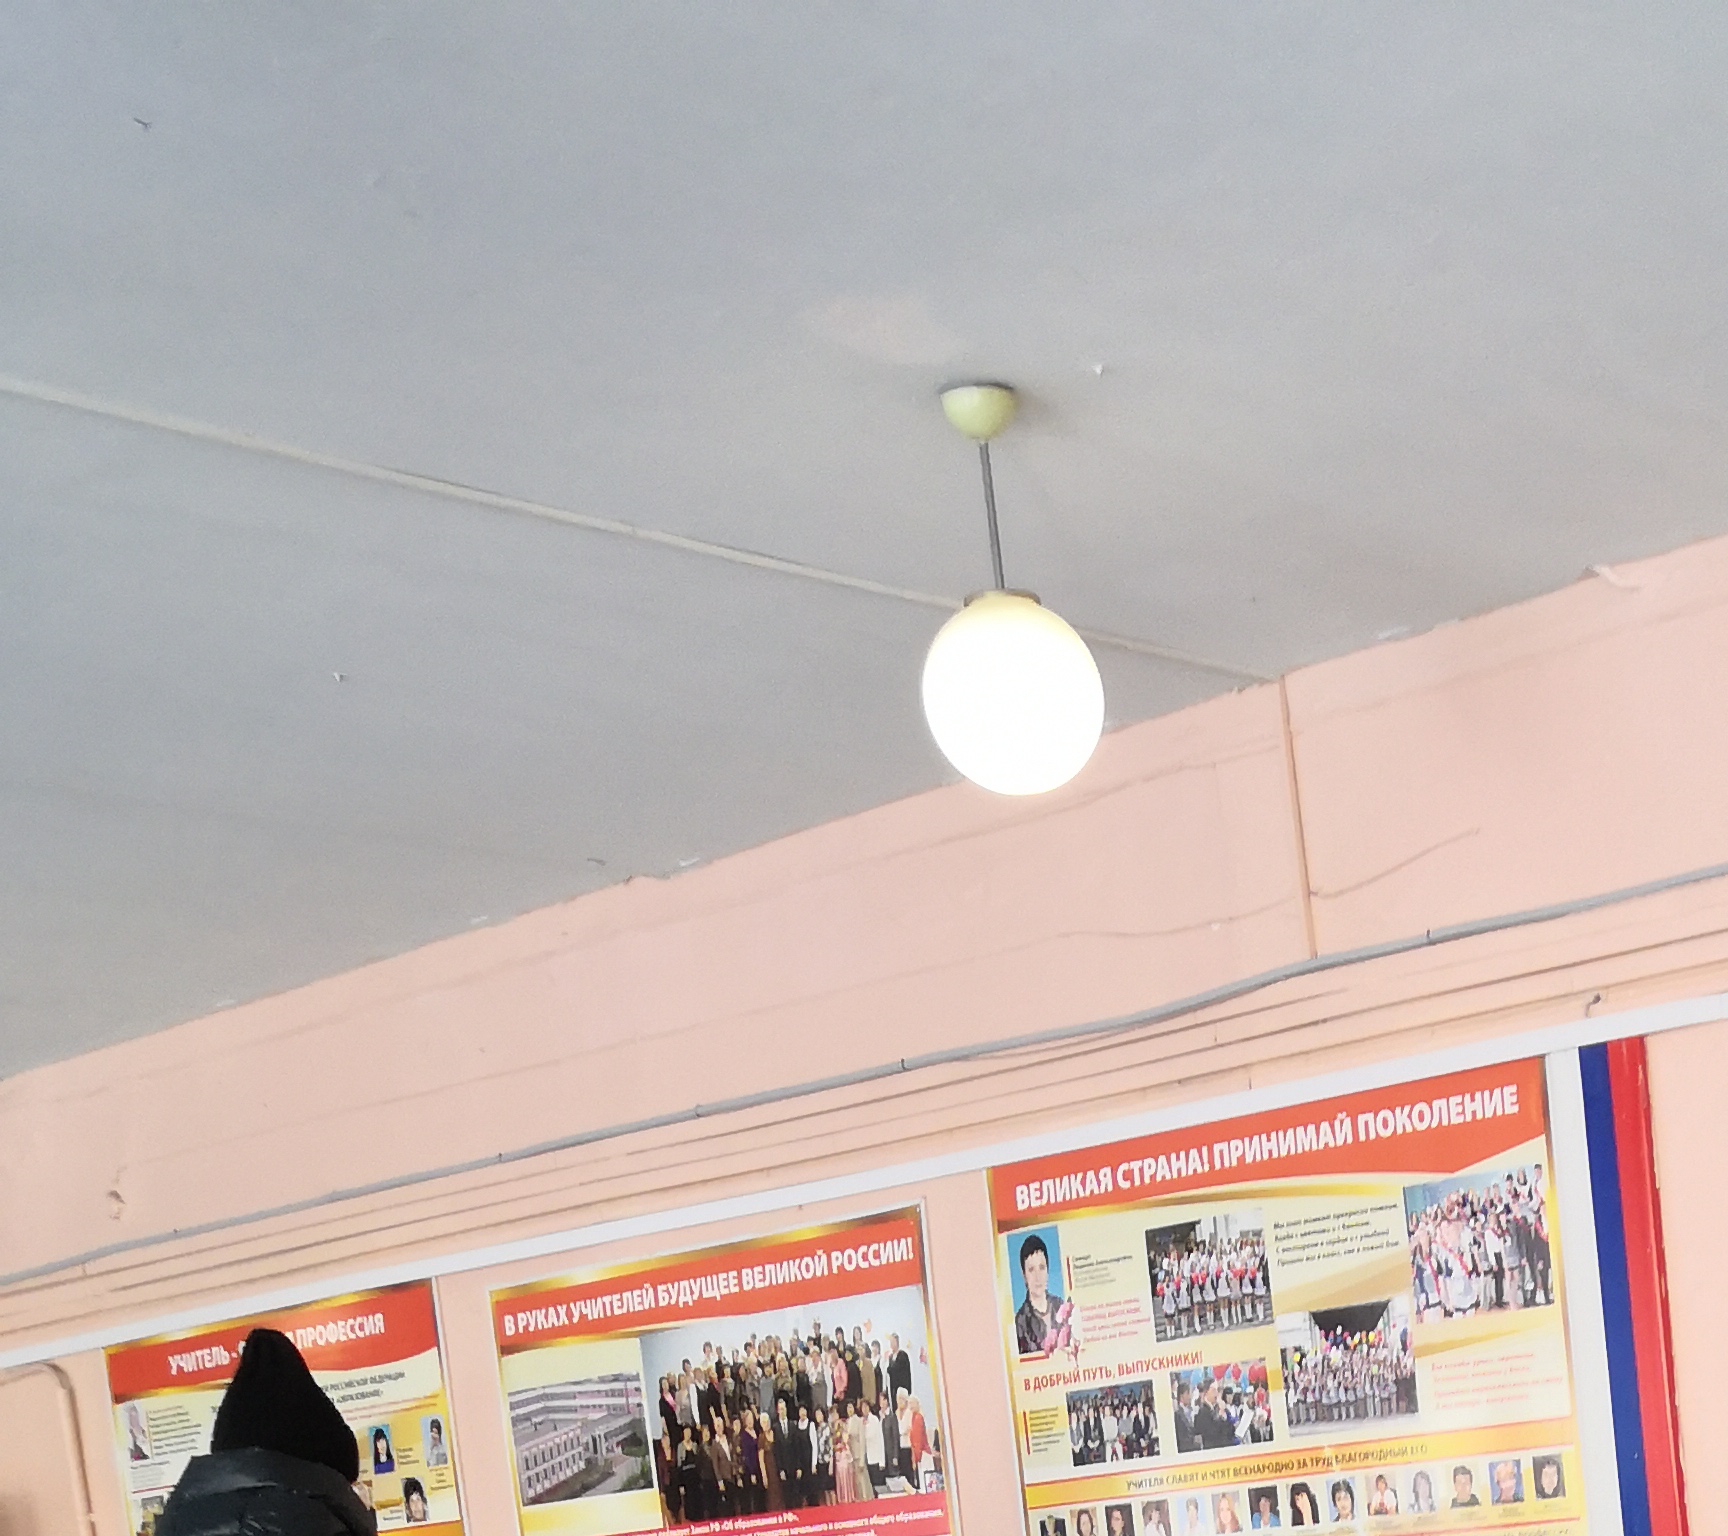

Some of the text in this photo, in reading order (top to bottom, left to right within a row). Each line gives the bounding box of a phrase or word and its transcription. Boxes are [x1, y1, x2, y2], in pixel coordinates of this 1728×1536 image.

[1015, 1084, 1519, 1211] ВЕЛИКАЯ СТРАНА! ПРИНИМАЙ ПОКОЛЕНИЕ
[503, 1237, 914, 1337] В РУКАХ УЧИТЕЛЕЙ БУДУЩЕЕ ВЕЛИКОЙ РОССИИ!
[296, 1313, 385, 1350] ПРОФЕССИЯ
[167, 1345, 230, 1375] УЧИТЕЛЬ
[1024, 1350, 1203, 1393] В ДОБРЫЙ ПУТЬ, ВЫПУСКНИКИ!
